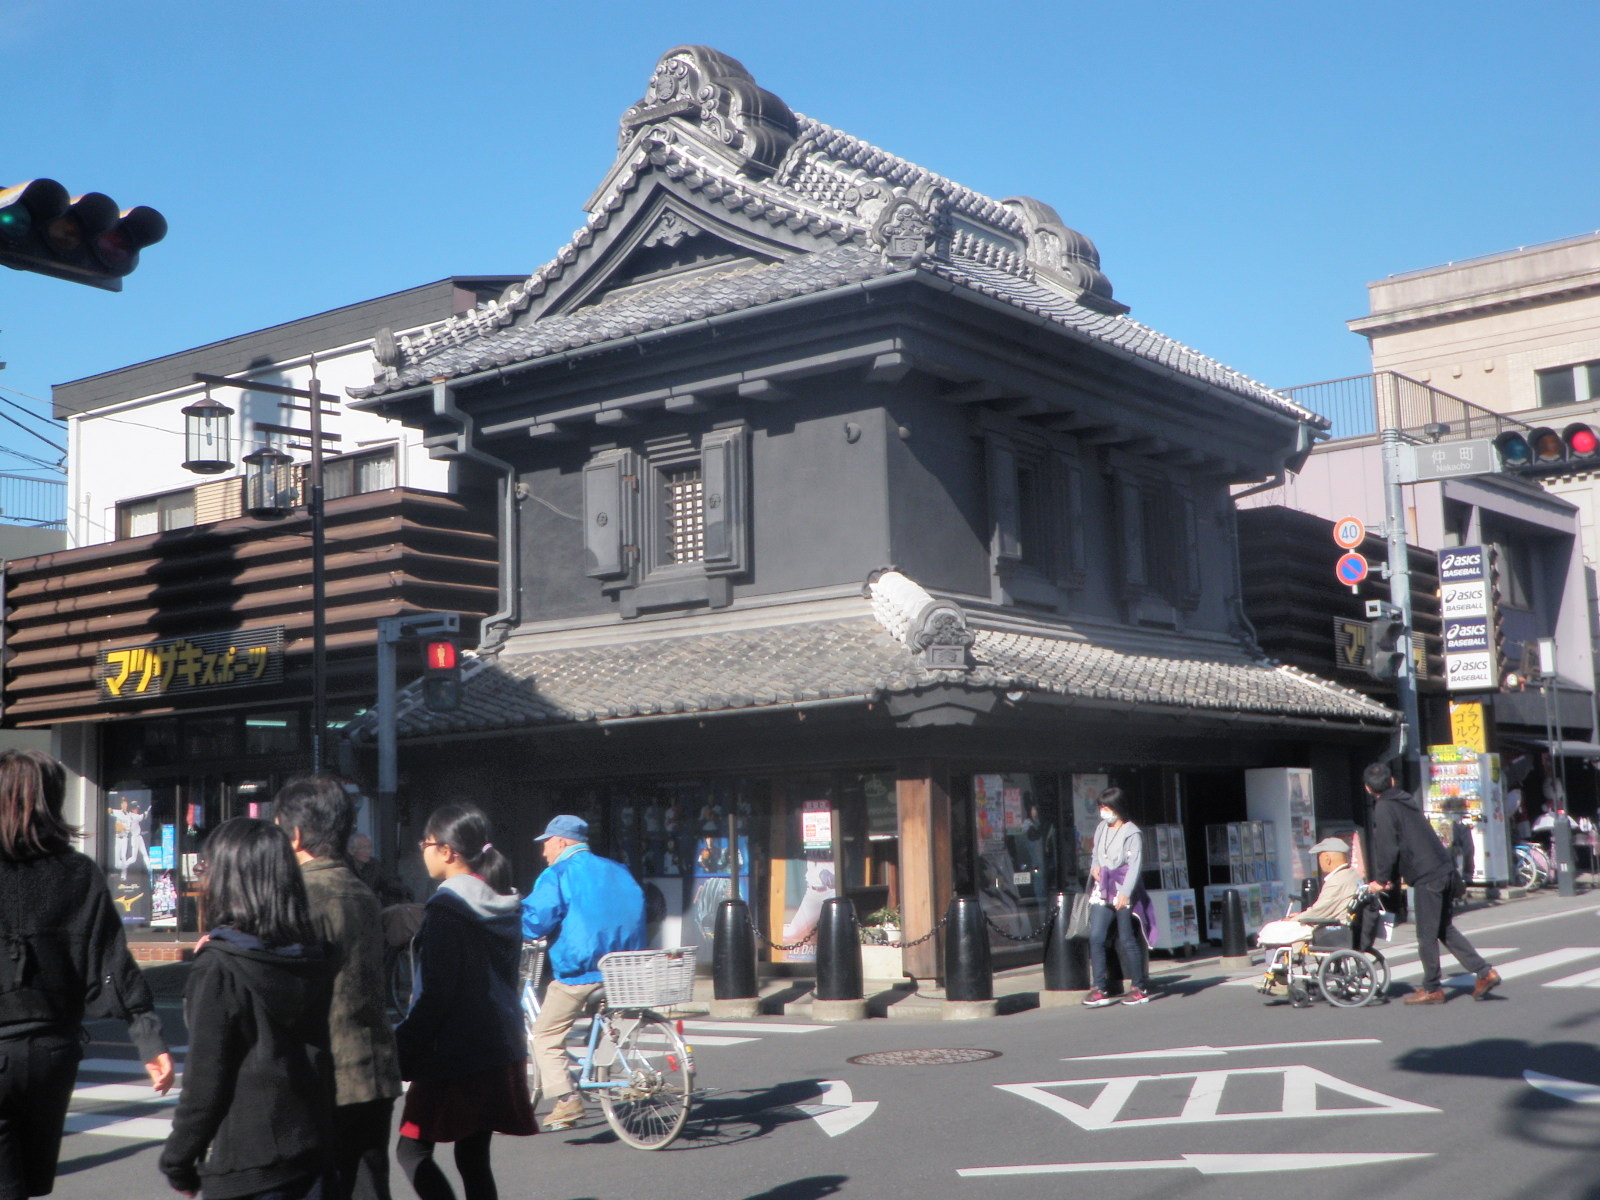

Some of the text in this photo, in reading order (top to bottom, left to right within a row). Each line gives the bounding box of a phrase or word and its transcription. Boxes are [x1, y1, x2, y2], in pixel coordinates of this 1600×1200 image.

[1431, 446, 1473, 464] 仲町
[1436, 463, 1471, 473] Nakacho
[1341, 524, 1358, 539] 40
[1442, 567, 1481, 578] BASEBALL
[1445, 602, 1483, 612] BASEBALL
[1447, 637, 1486, 648] BASEBALL
[105, 639, 268, 696] マツザキスポーツ
[1450, 673, 1488, 682] BASEBALL
